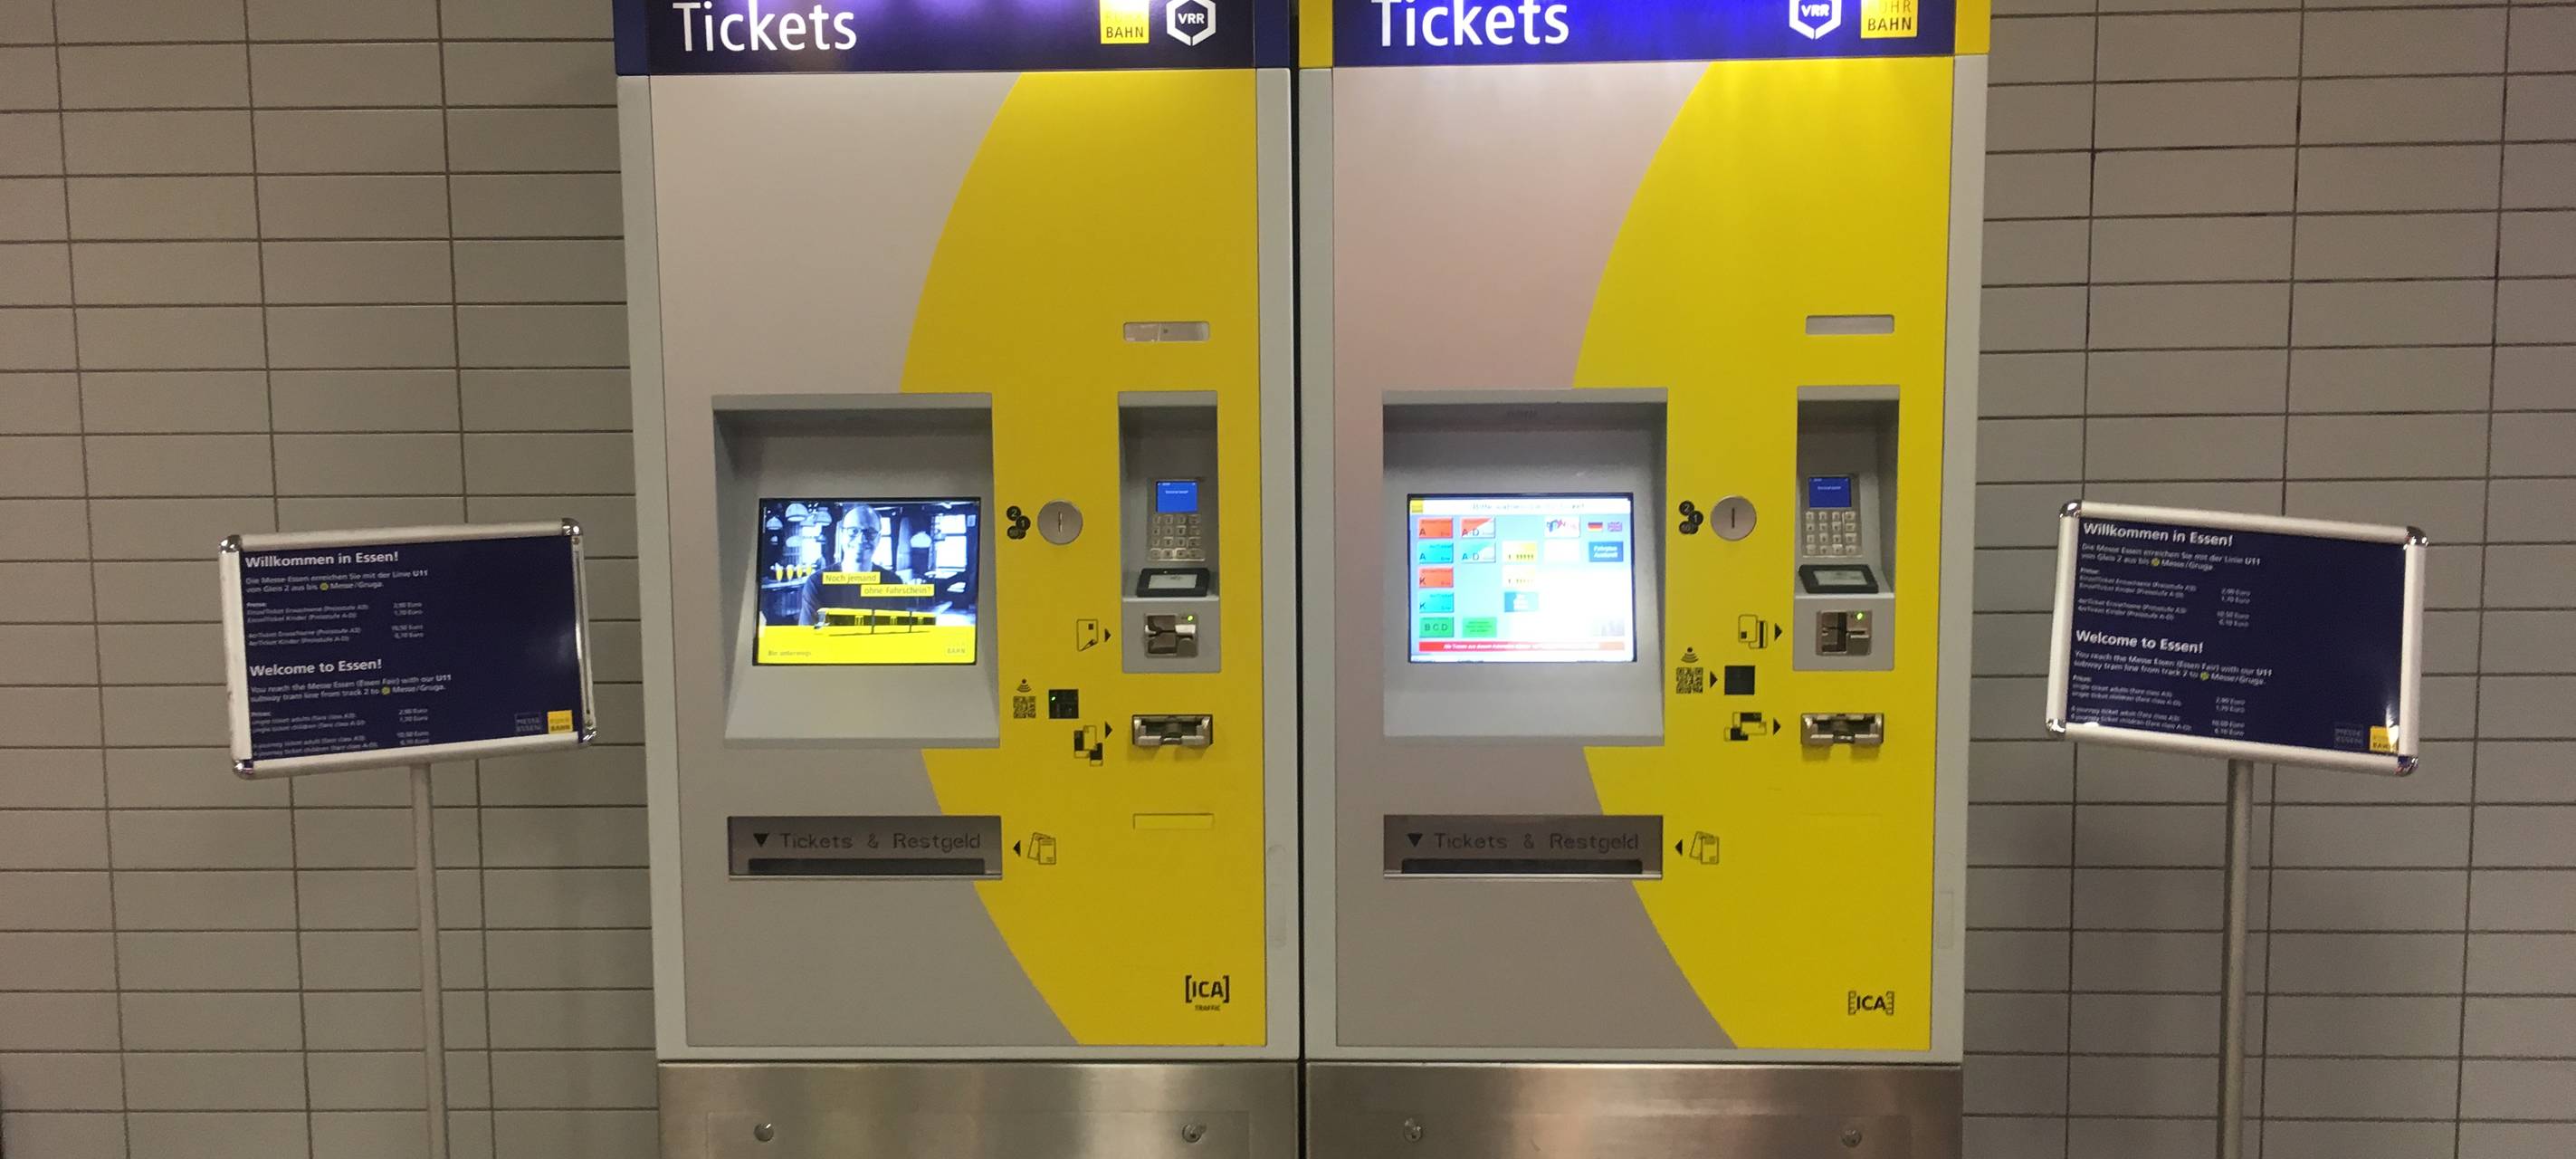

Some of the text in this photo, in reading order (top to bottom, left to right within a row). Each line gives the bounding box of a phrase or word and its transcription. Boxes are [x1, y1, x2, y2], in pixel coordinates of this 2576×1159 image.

[1178, 13, 1205, 24] VRR
[1800, 4, 1830, 17] VRR
[673, 0, 857, 52] Tickets
[1106, 26, 1144, 38] BAHN
[1370, 0, 1569, 46] Tickets
[1867, 16, 1912, 31] BAHN
[2083, 522, 2232, 547] Willkommen in Essen!
[244, 551, 398, 569] Willkommen in Essen!
[825, 574, 876, 584] Noch jemand
[864, 586, 883, 594] ohne
[2075, 629, 2203, 654] Welcome to Essen!
[249, 658, 381, 677] Welcome to Essen!
[779, 832, 980, 852] Tickets & Restgeld
[1434, 832, 1638, 854] Tickets & Restgeld
